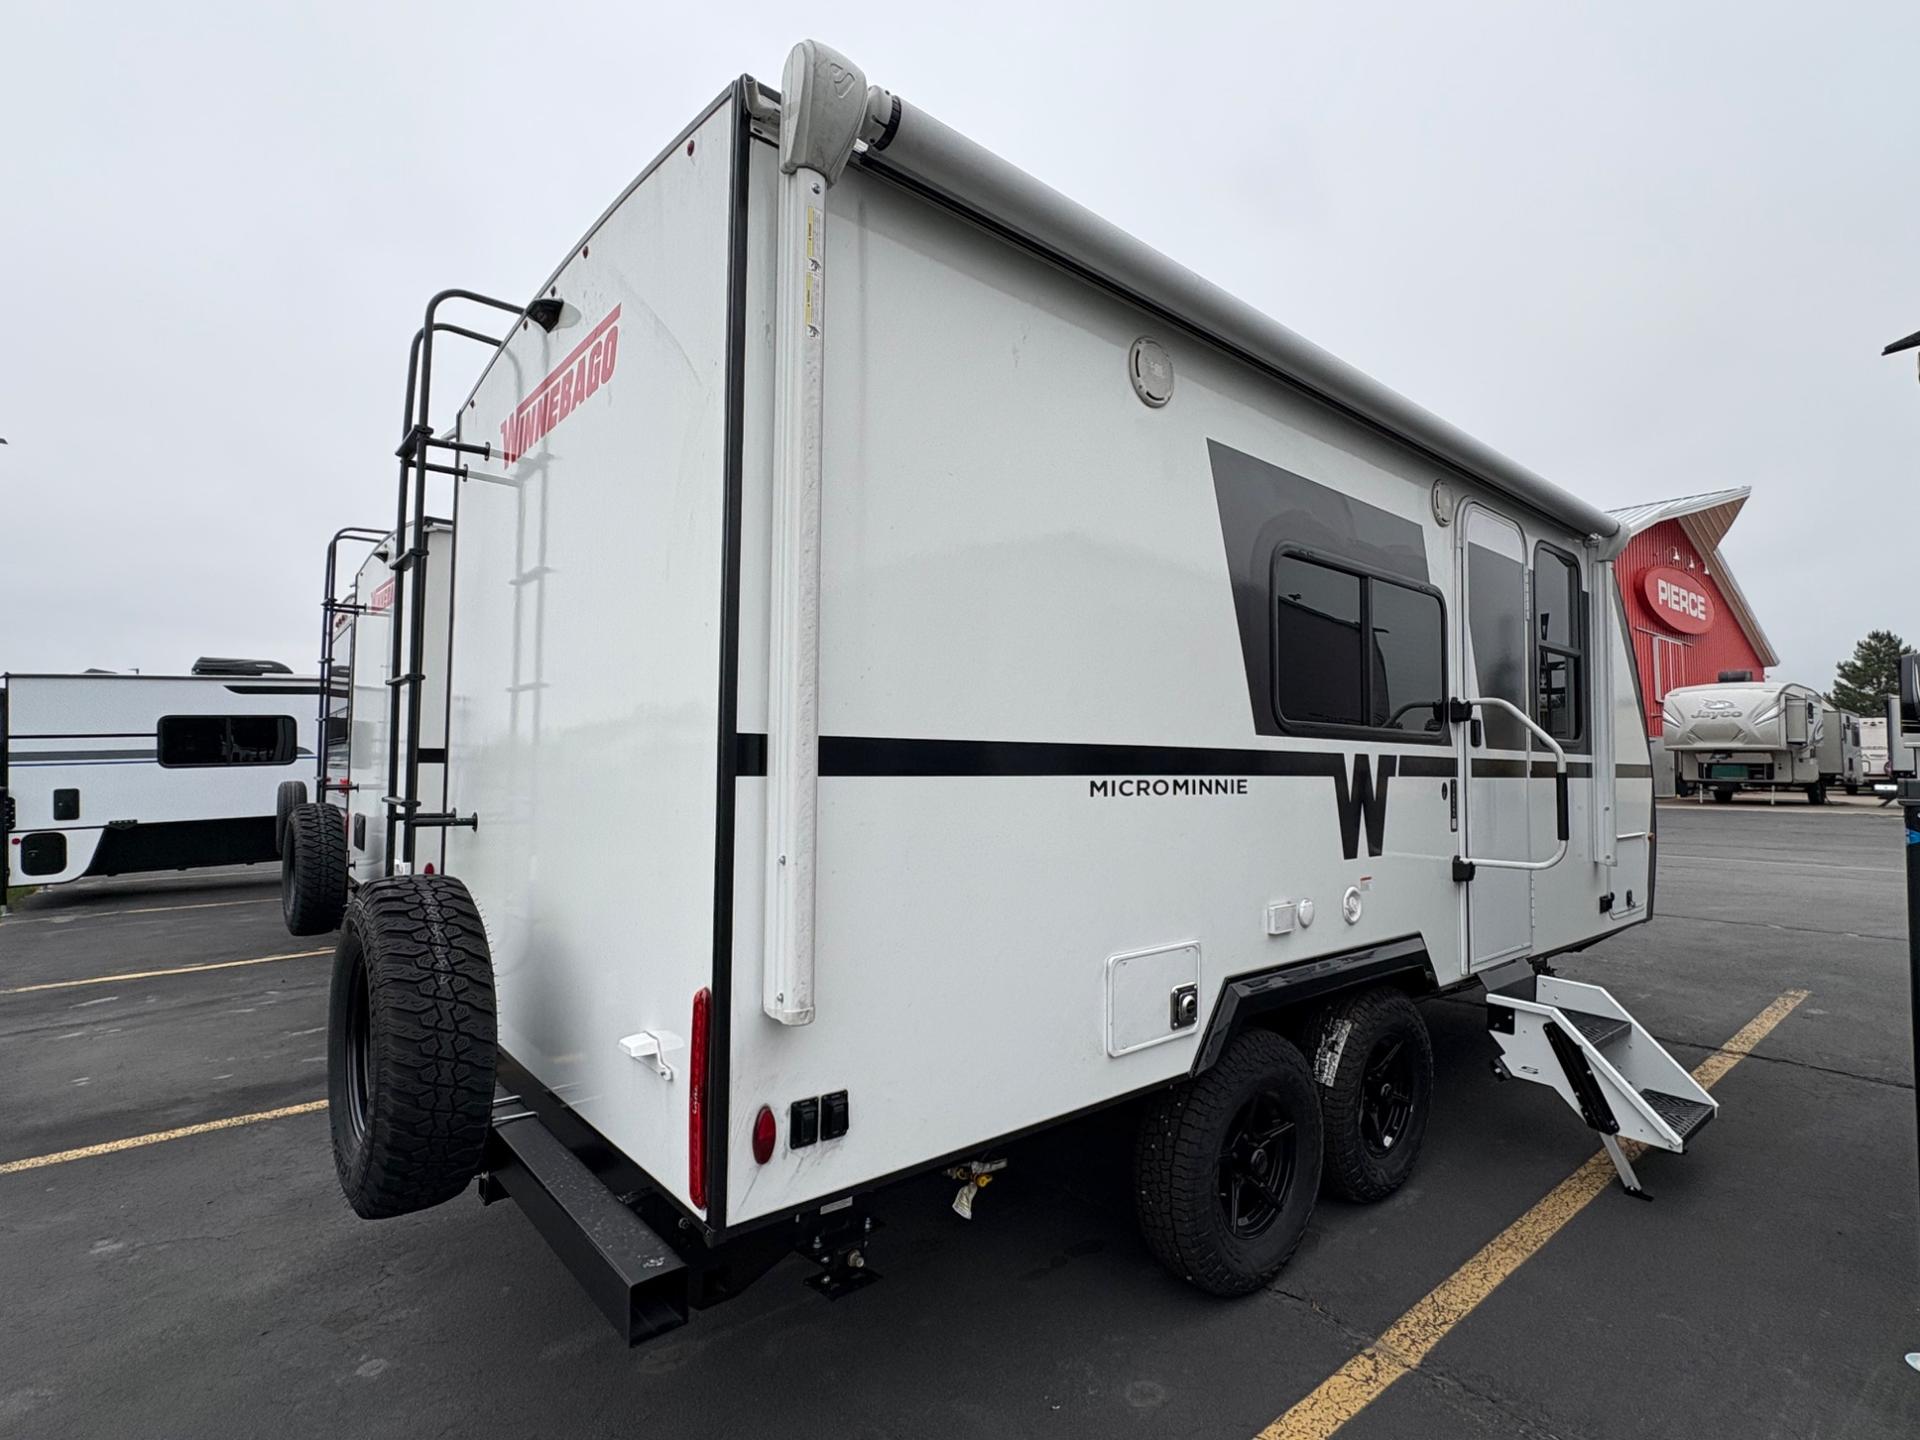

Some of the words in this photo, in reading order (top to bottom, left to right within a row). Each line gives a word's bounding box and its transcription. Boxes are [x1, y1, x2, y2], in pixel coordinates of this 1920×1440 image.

[501, 304, 622, 470] WINNEBAGO
[1658, 578, 1706, 620] PIERCE
[1690, 709, 1743, 720] Jayco
[1089, 779, 1248, 797] MICROMINNIE
